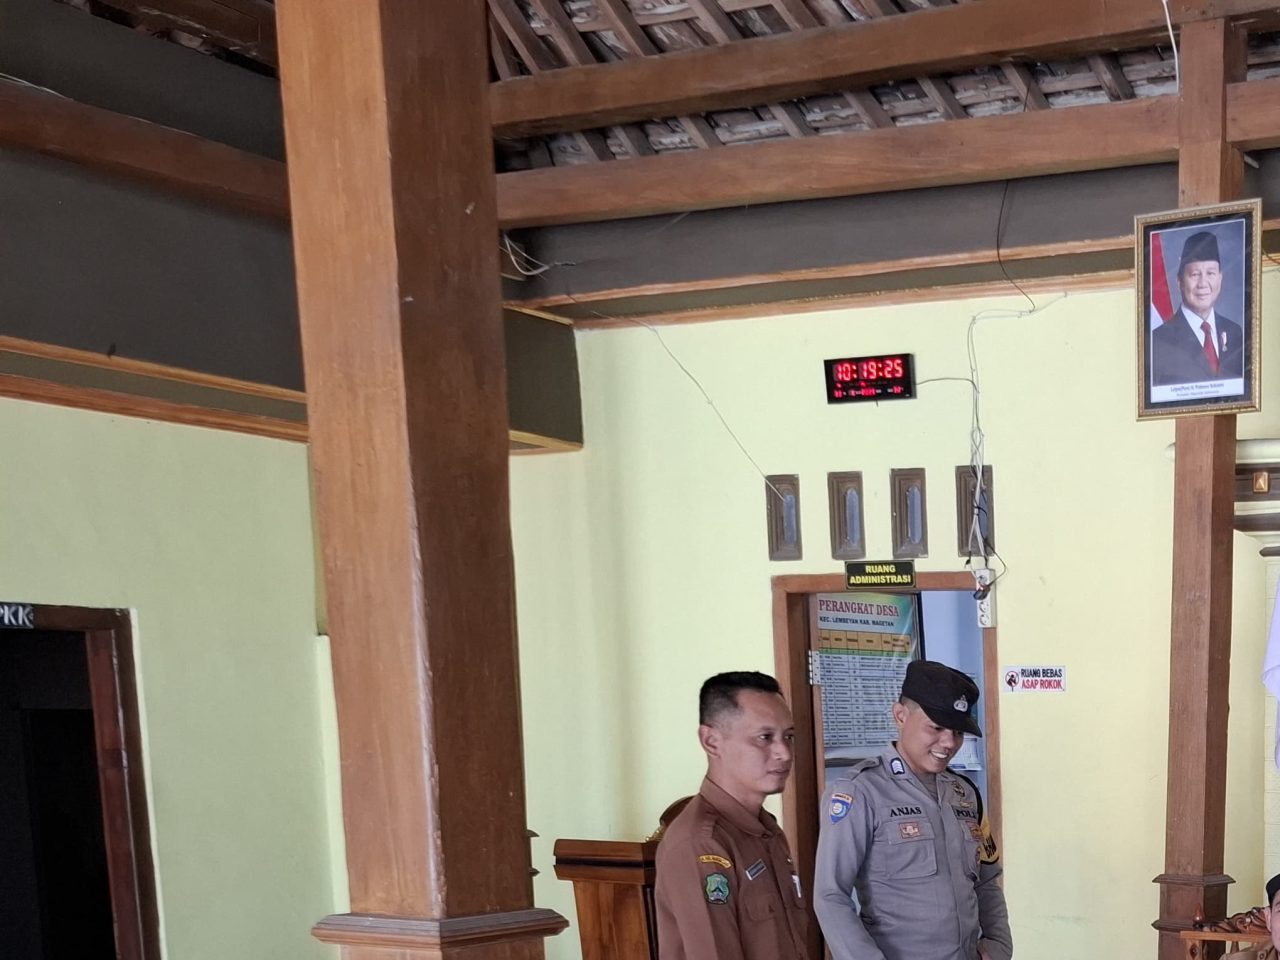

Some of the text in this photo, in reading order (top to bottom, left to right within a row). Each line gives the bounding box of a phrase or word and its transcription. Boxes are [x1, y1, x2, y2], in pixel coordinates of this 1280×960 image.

[836, 359, 904, 381] 10:19:25
[865, 564, 896, 574] RUANG
[849, 574, 912, 585] ADMINISTRASI
[818, 599, 900, 617] PERANGKAT DESA
[0, 605, 34, 629] KK
[1020, 668, 1063, 678] RUANG BEBAS
[1021, 679, 1062, 690] ASAP ROKOK
[890, 806, 922, 817] ANJAS
